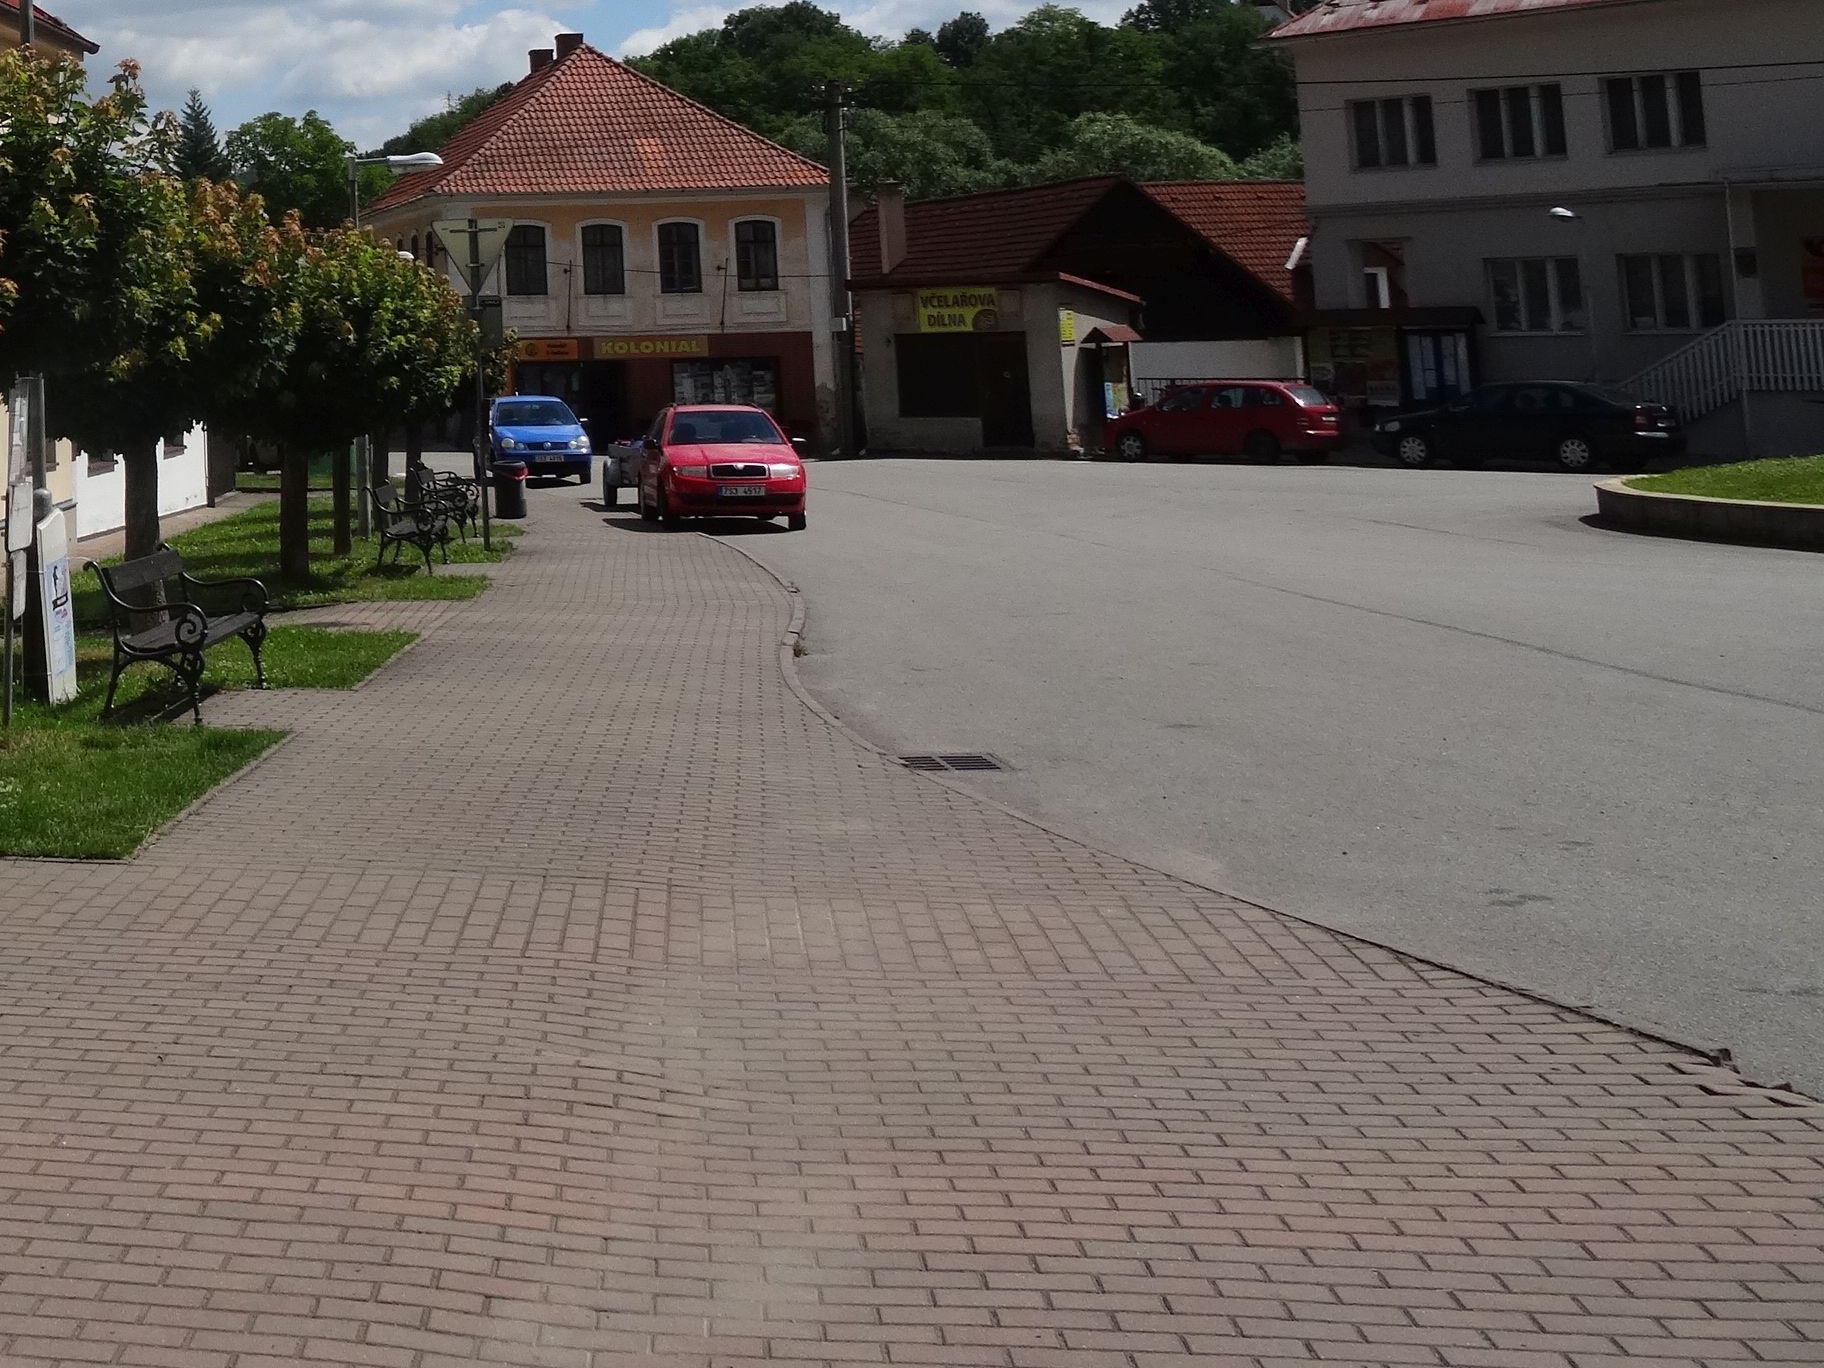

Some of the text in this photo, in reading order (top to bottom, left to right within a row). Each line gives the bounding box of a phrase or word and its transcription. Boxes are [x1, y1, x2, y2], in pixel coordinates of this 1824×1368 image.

[920, 291, 996, 308] VČELAŘOVA
[927, 311, 968, 328] DÍLNA
[600, 339, 701, 355] KOLONIAL
